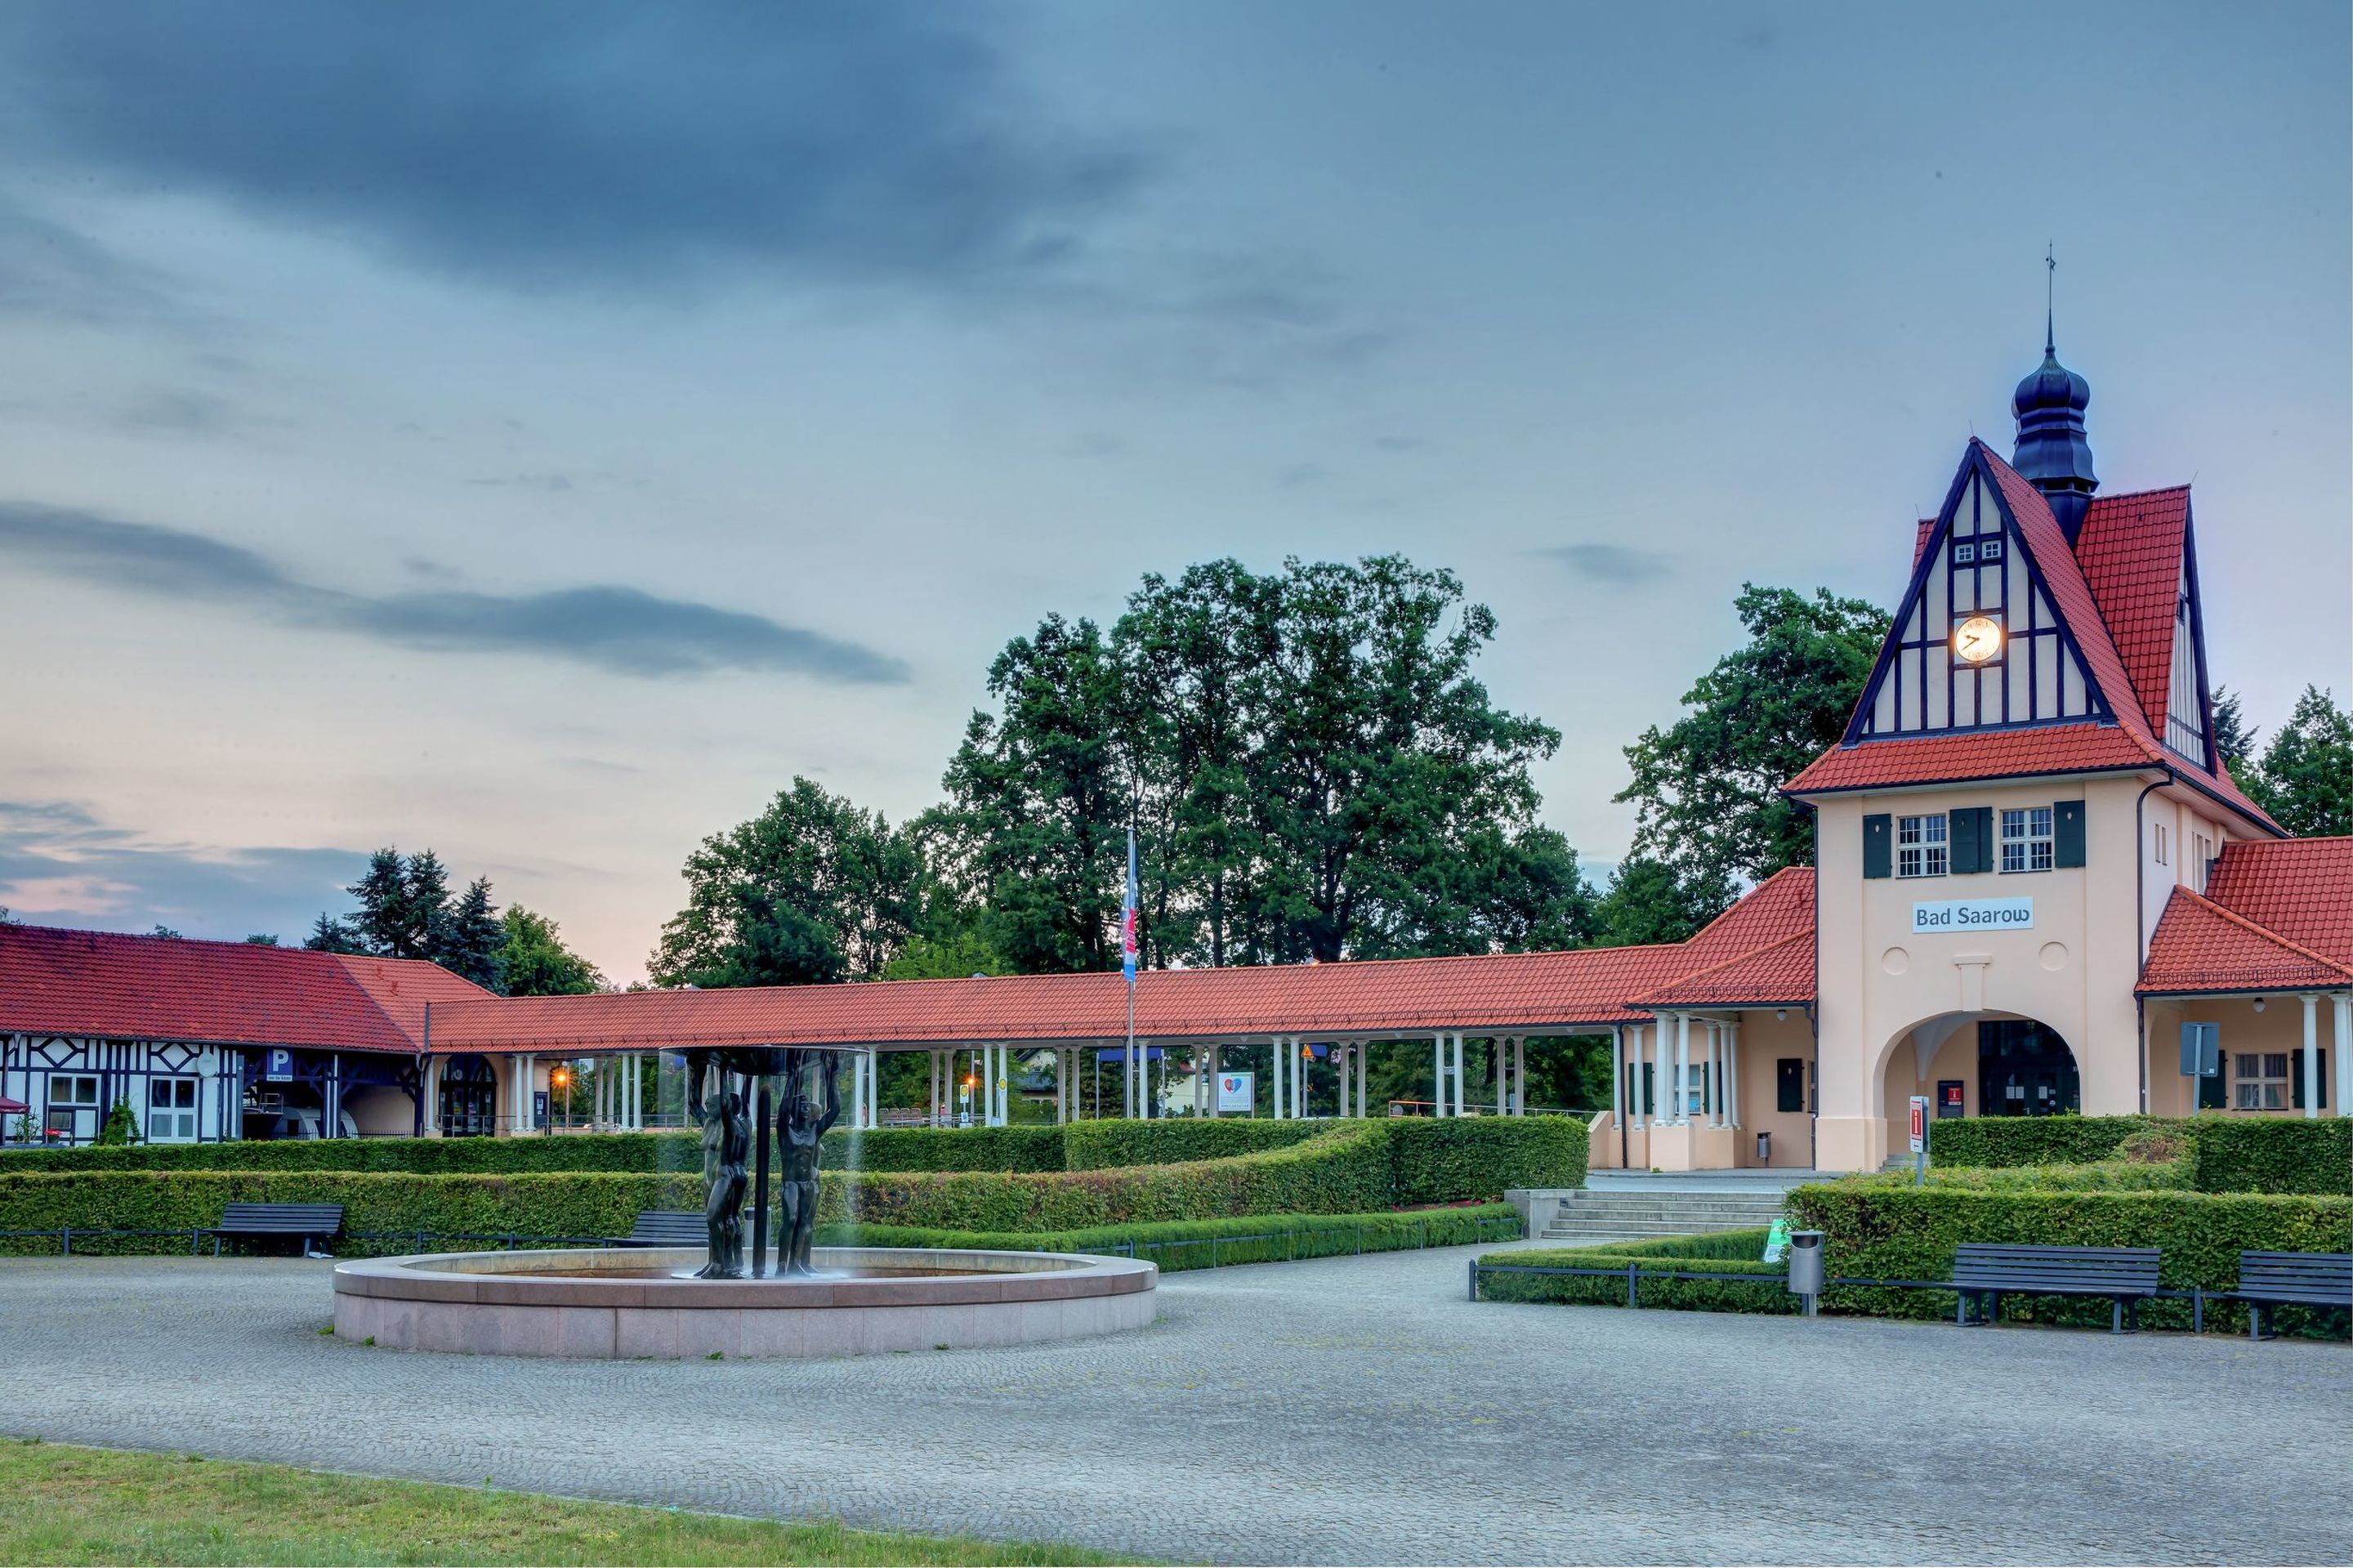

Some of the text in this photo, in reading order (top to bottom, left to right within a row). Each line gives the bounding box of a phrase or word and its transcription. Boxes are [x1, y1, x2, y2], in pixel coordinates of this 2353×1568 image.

[1917, 907, 2030, 926] Bad Saarow
[273, 1049, 289, 1072] P
